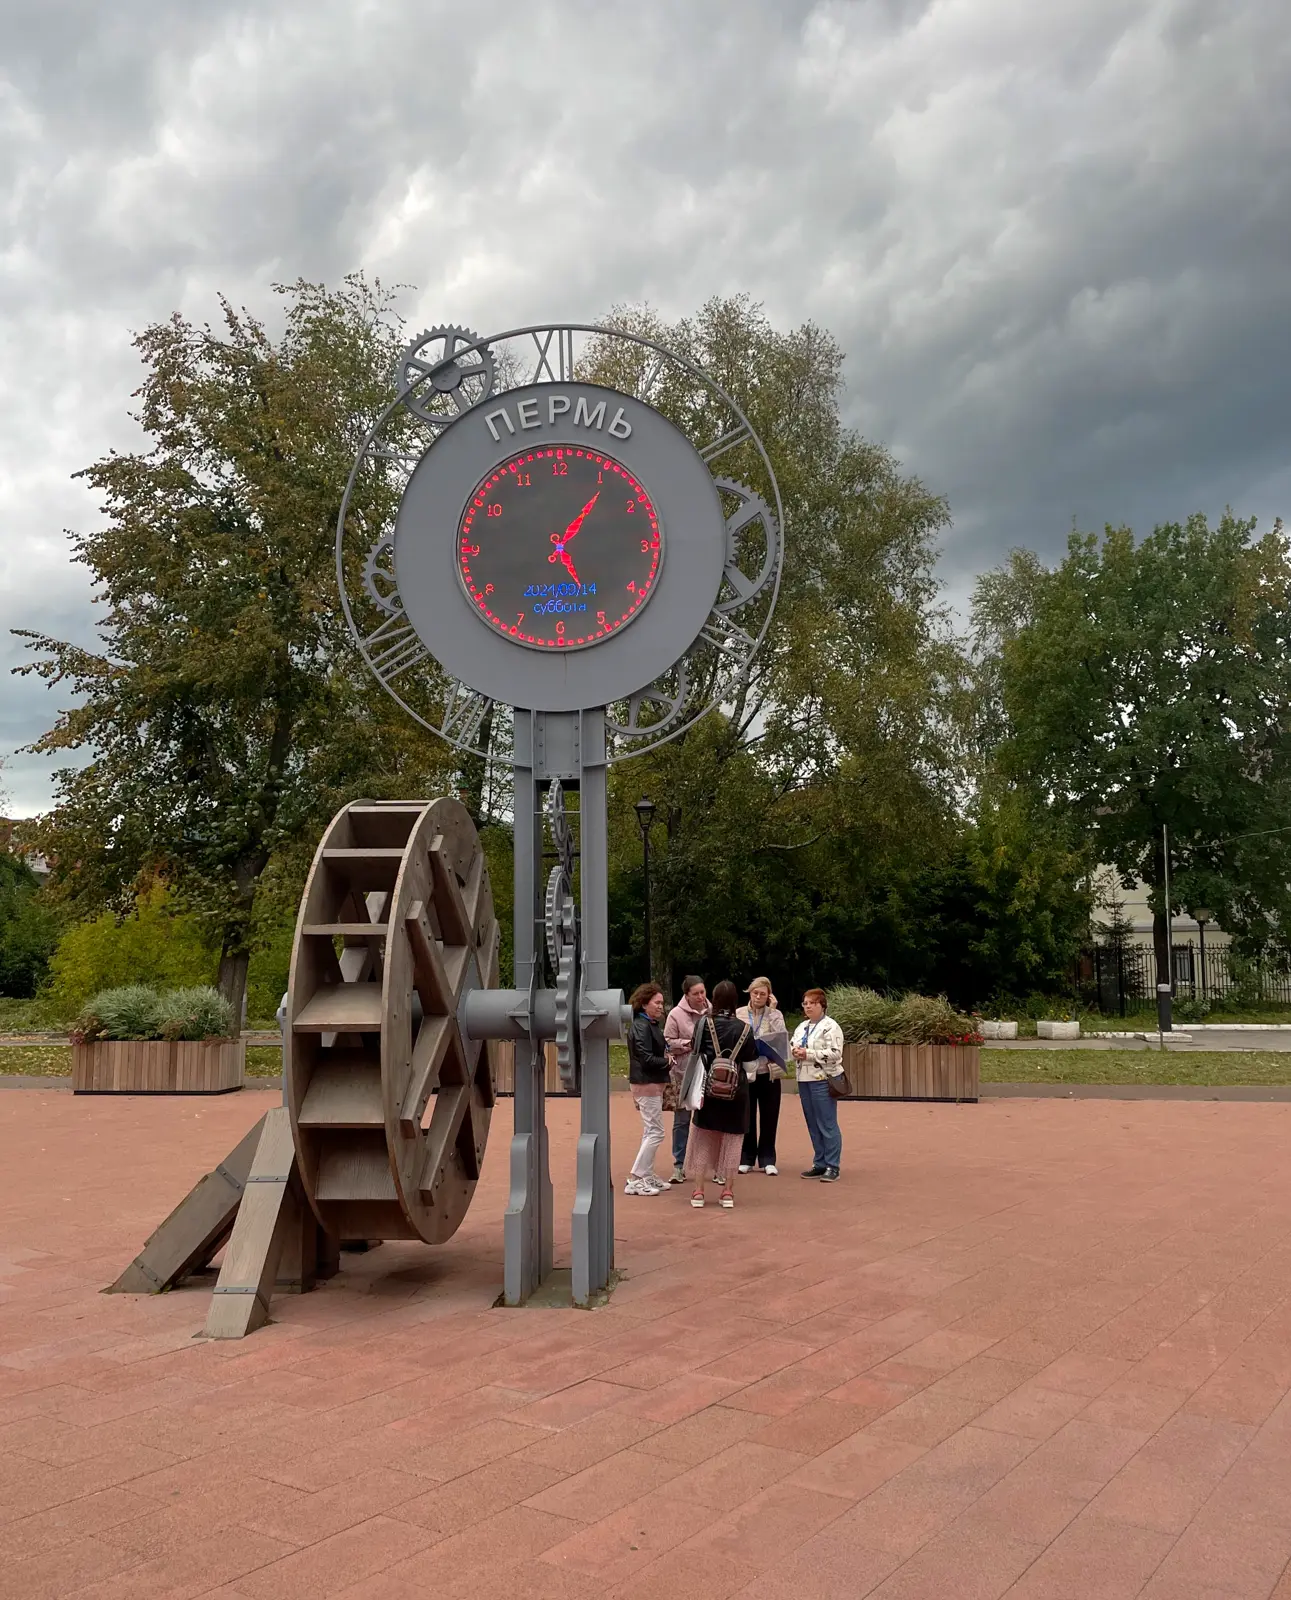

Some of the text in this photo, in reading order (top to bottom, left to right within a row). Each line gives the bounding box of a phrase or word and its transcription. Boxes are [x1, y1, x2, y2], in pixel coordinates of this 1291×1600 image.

[531, 328, 574, 383] XII
[484, 395, 633, 442] ПЕРМЬ
[552, 463, 568, 476] 12
[517, 474, 532, 486] 11
[597, 472, 603, 484] 1
[487, 504, 502, 517] 10
[626, 501, 635, 513] 2
[471, 545, 480, 557] 9
[640, 540, 649, 553] 3
[485, 583, 495, 596] 8
[626, 580, 636, 593] 4
[516, 613, 525, 626] 7
[597, 611, 606, 624] 5
[556, 621, 565, 634] 6
